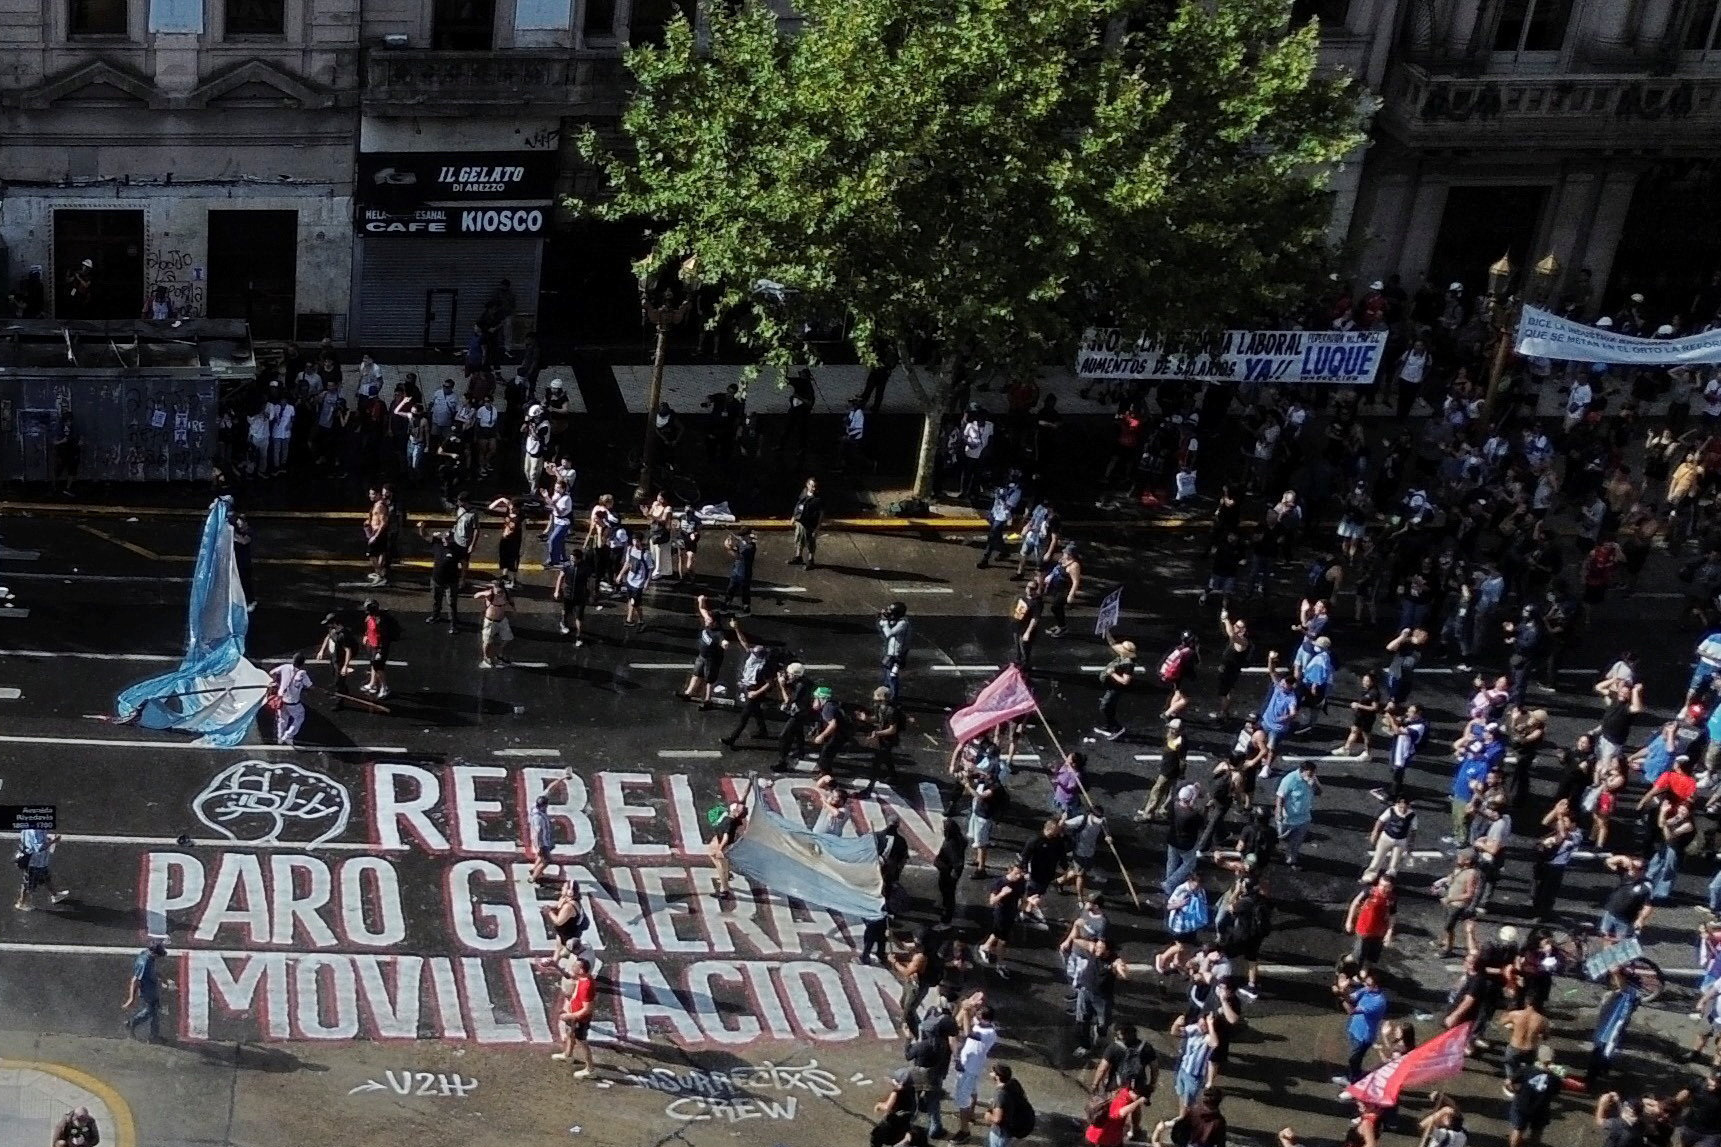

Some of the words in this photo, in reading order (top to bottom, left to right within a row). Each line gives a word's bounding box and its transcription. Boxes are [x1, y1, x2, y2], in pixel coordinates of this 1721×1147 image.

[437, 166, 456, 182] IL
[458, 166, 525, 182] GELATO
[452, 184, 463, 192] DI
[465, 183, 505, 192] AREZZO
[365, 222, 447, 232] CAFE
[461, 210, 543, 232] KIOSCO
[1236, 332, 1302, 356] LABORAL
[1524, 328, 1547, 340] QUE
[1549, 332, 1565, 342] SE
[1080, 357, 1148, 375] AUMENTOS
[1152, 358, 1171, 376] DE
[1300, 345, 1377, 377] LUQUE
[145, 852, 406, 946] PARO
[448, 858, 868, 952] GENERA
[184, 952, 940, 1043] MOVILIACION
[665, 1095, 797, 1123] CREW
